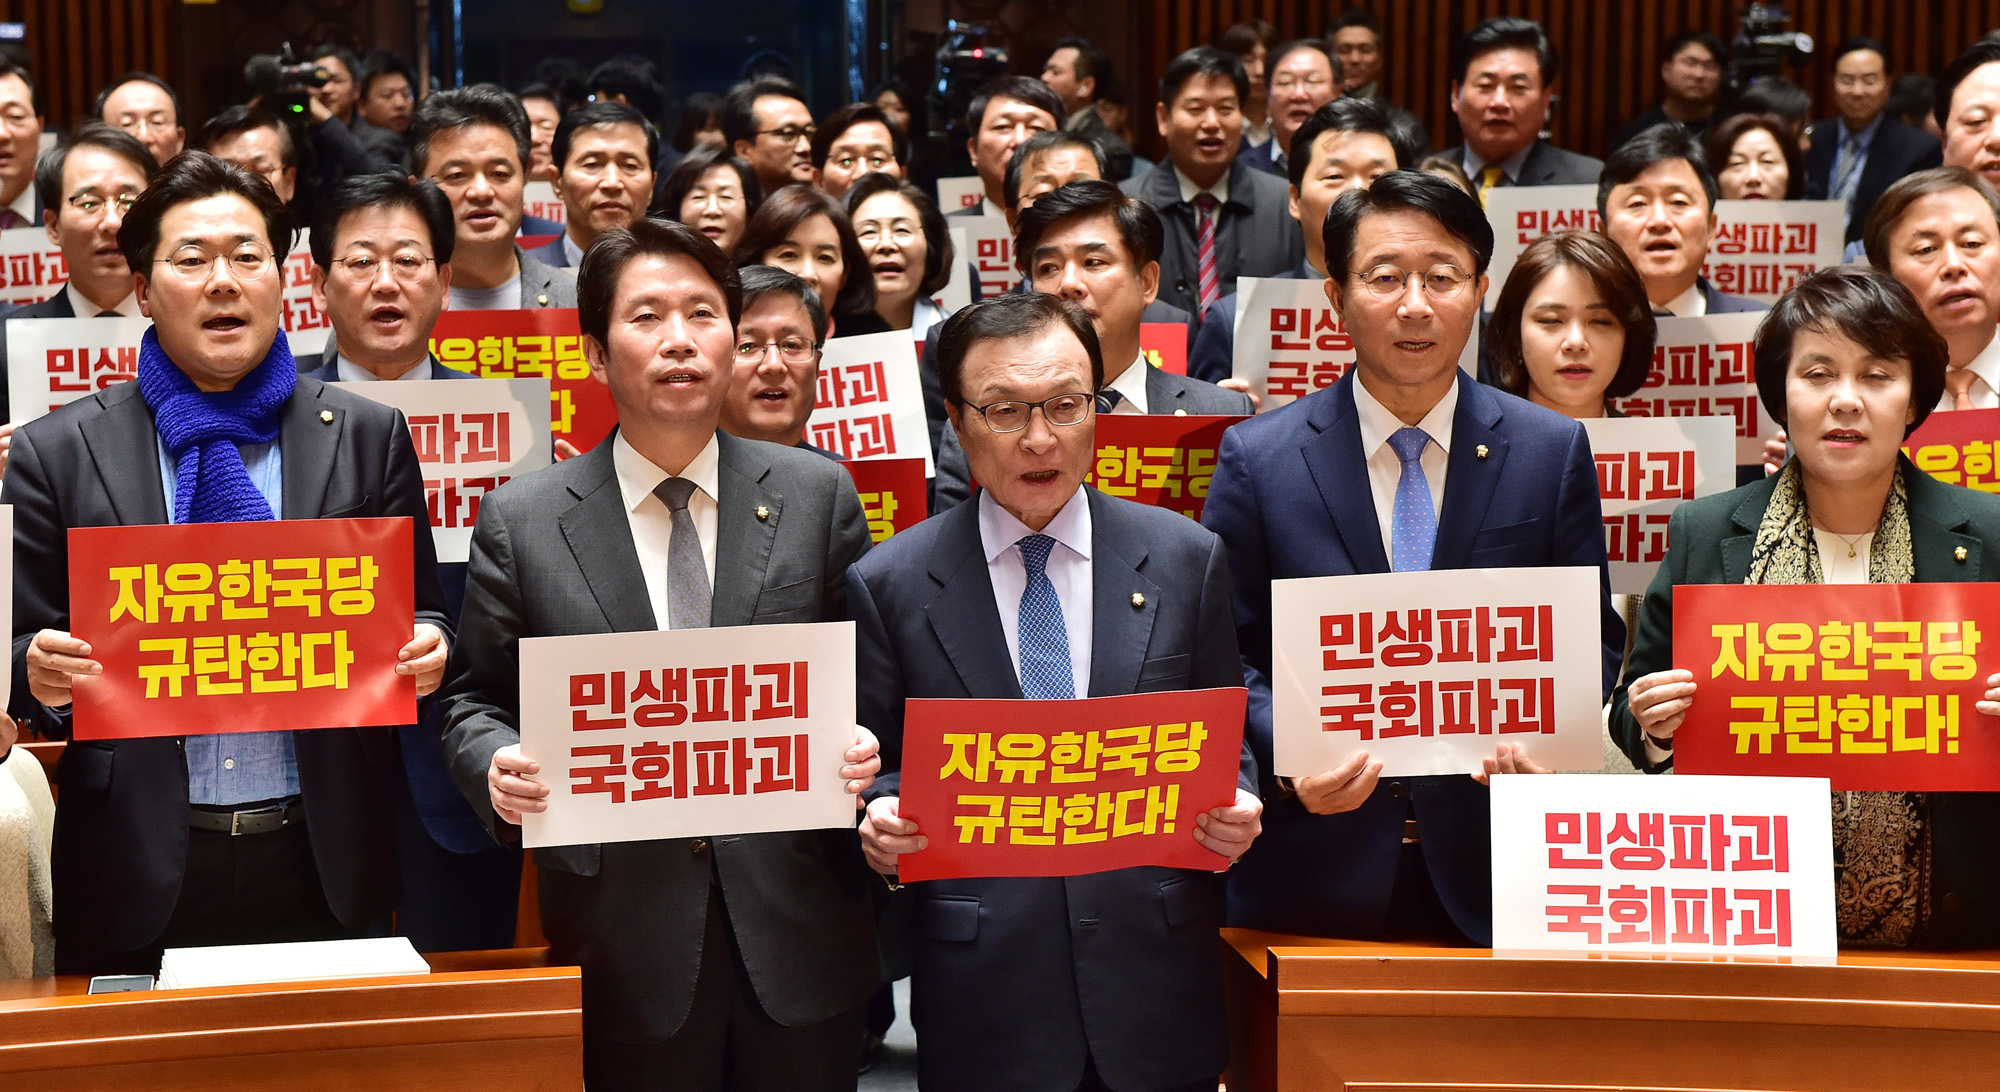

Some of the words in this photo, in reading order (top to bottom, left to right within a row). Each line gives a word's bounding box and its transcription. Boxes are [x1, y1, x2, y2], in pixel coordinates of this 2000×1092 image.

[1707, 224, 1816, 254] 생파괴
[429, 336, 591, 379] 유한국당
[814, 361, 888, 409] 파괴
[407, 412, 510, 463] 파괴
[802, 413, 897, 459] 파괴
[1594, 450, 1695, 500] 파괴
[109, 556, 379, 623] 자유한국당
[138, 630, 354, 698] 규탄한다
[1320, 605, 1553, 671] 민생파괴
[1711, 620, 1981, 681] 자유한국당
[569, 661, 808, 731] 민생파괴
[1320, 677, 1555, 740] 국회파괴
[1729, 694, 1960, 754] 규탄한다!
[569, 734, 809, 803] 국회파괴
[940, 721, 1208, 783] 자유한국당
[954, 784, 1180, 845] 규탄한다!
[1545, 812, 1789, 873] 민생파괴
[1545, 884, 1792, 947] 국회파괴
